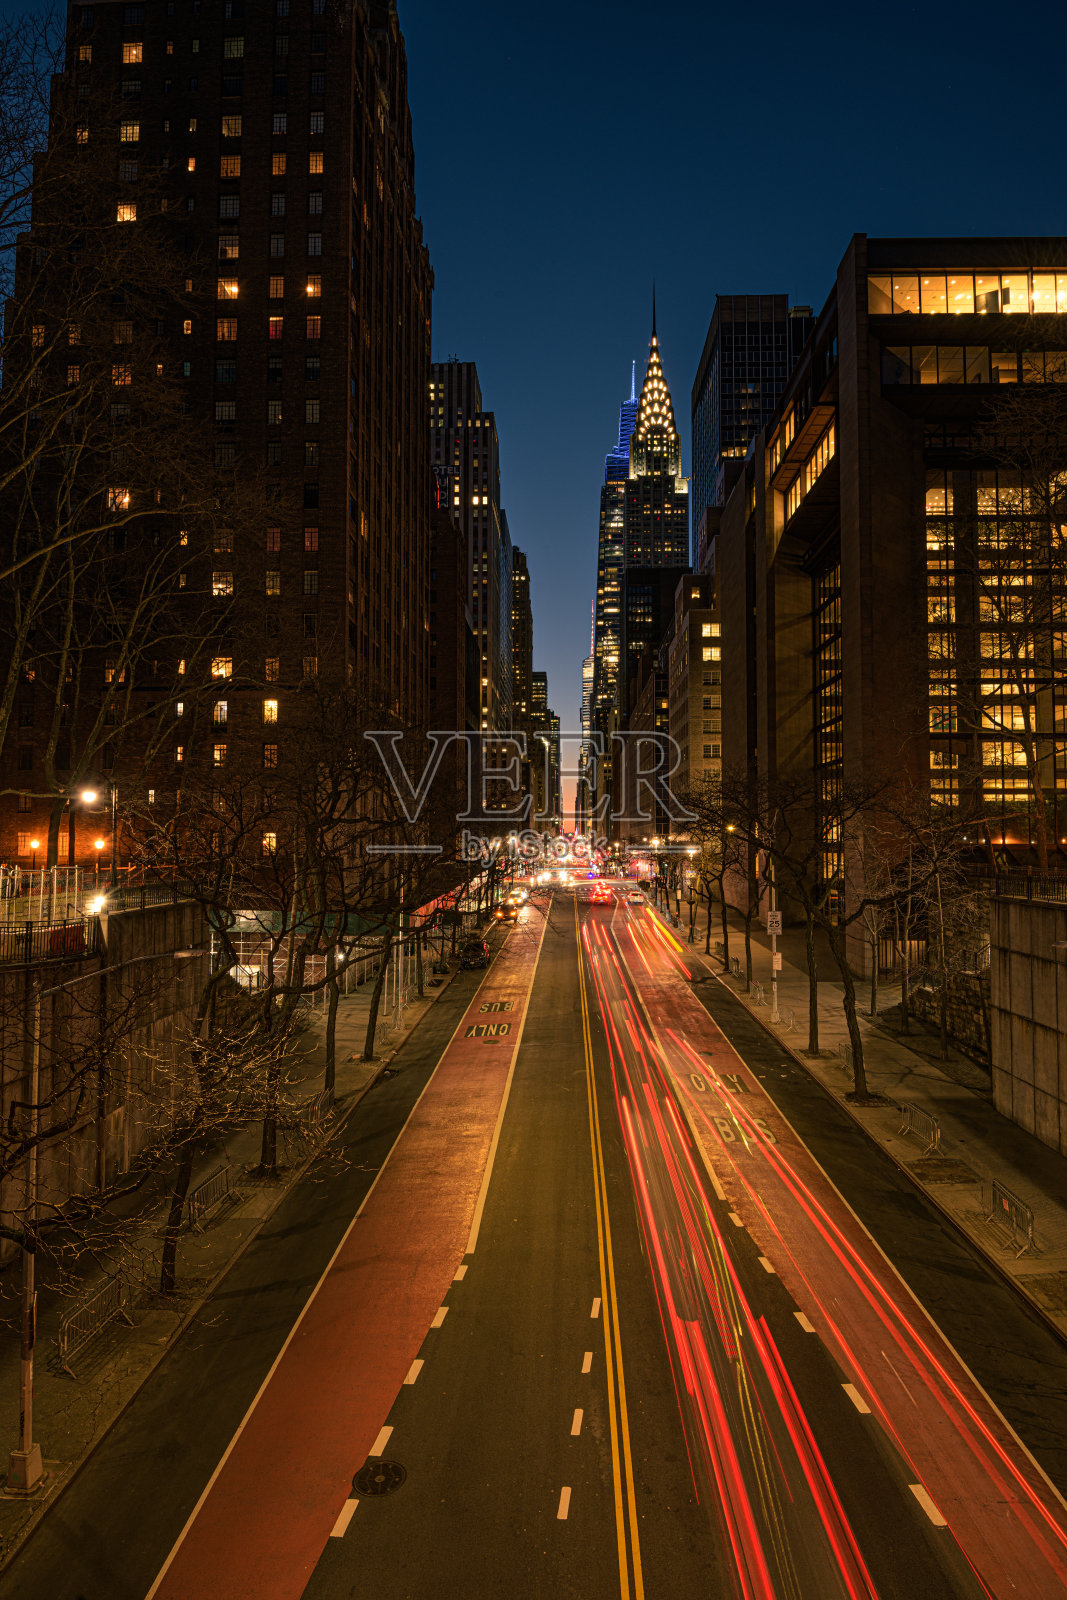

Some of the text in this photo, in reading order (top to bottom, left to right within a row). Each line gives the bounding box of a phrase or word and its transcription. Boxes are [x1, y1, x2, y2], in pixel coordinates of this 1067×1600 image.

[432, 465, 460, 475] OTEL
[769, 920, 780, 928] 25
[480, 1002, 514, 1013] BUS
[467, 1024, 509, 1038] ONLY
